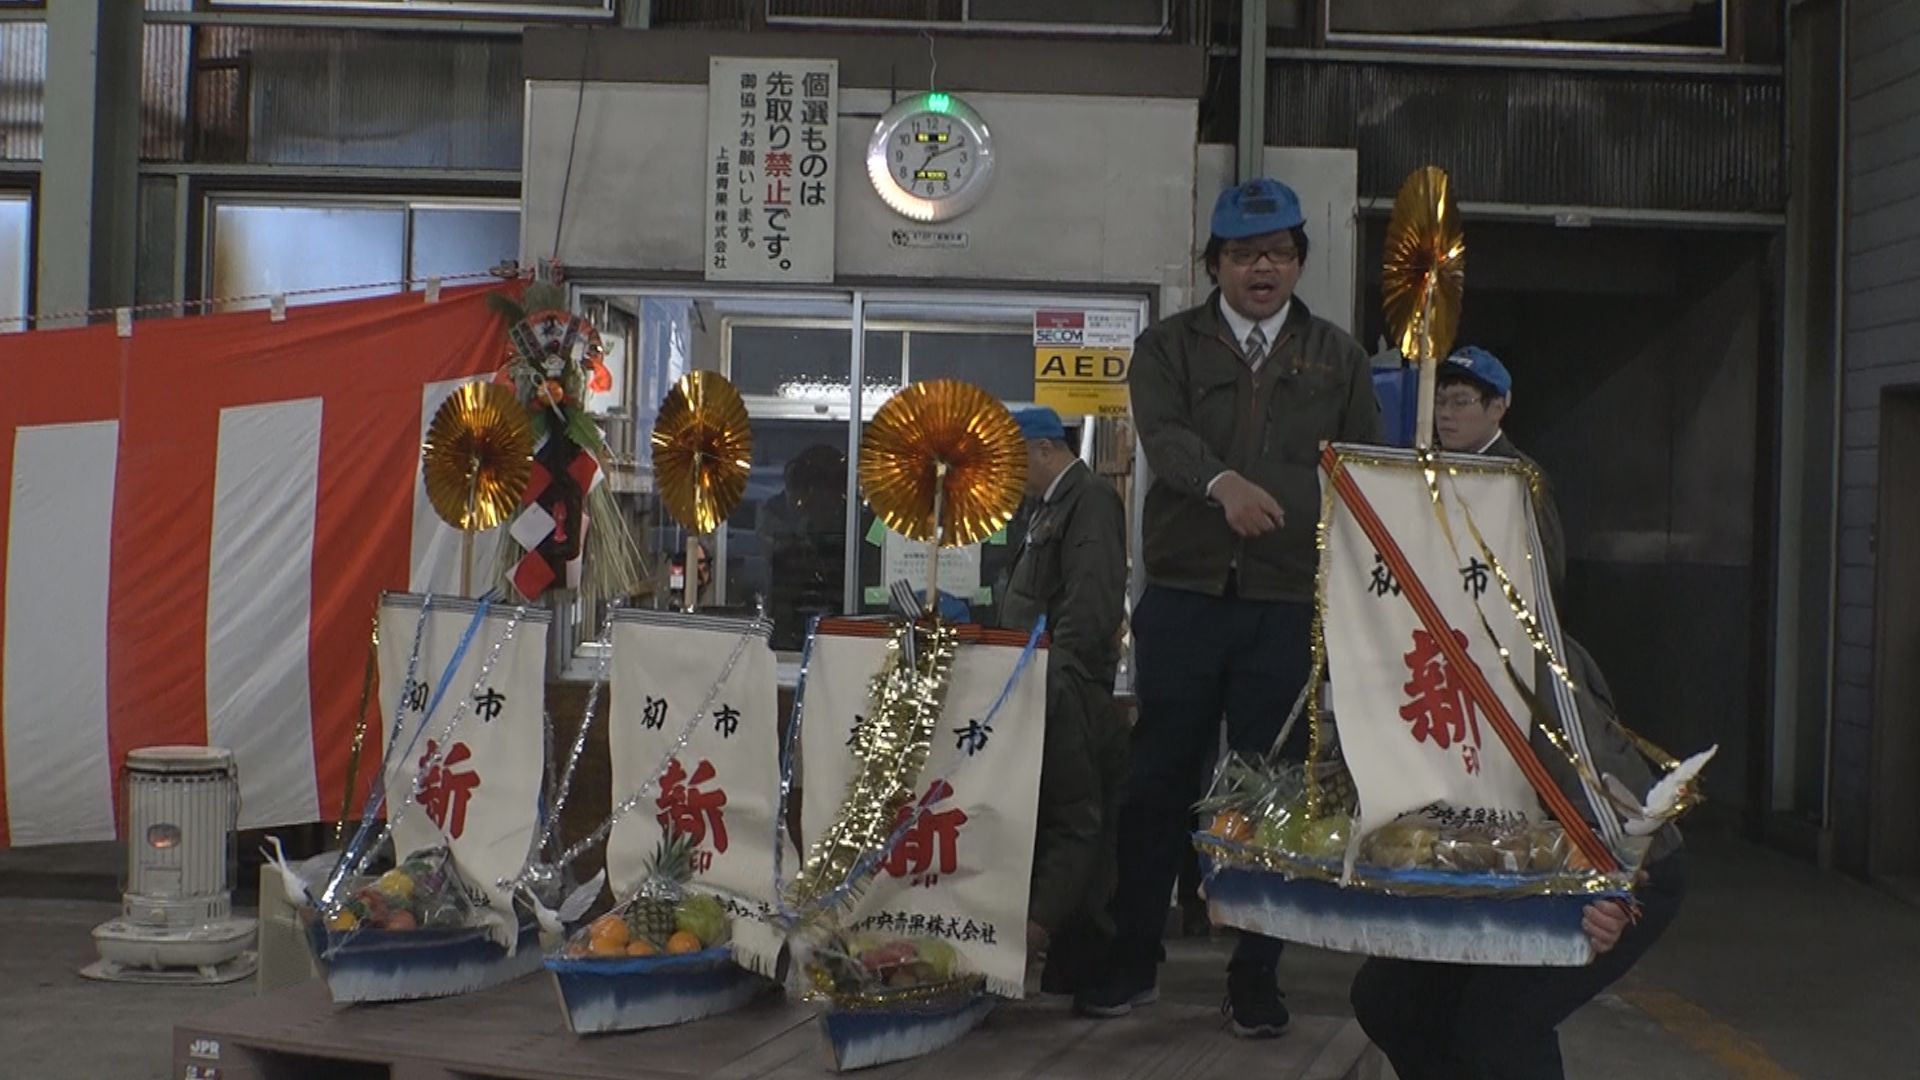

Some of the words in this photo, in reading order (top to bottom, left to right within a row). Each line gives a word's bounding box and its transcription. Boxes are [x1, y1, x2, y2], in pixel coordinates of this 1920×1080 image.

[927, 118, 939, 130] 12
[800, 71, 829, 206] 個選ものは
[901, 134, 911, 146] 10
[738, 74, 757, 249] 御協力お願いします。
[897, 150, 904, 162] 9
[961, 151, 967, 163] 3
[763, 71, 793, 270] 先取り禁止です。
[900, 166, 907, 179] 8
[955, 167, 961, 178] 4
[927, 182, 934, 194] 6
[943, 180, 950, 191] 5
[714, 146, 729, 269] 上越青果株式会社
[1036, 330, 1083, 341] SECOM
[1041, 355, 1125, 377] AED
[1459, 556, 1490, 600] 市
[1400, 628, 1482, 750] 新
[475, 687, 506, 722] 市
[641, 695, 668, 730] 初
[713, 704, 741, 739] 市
[953, 719, 993, 756] 市
[415, 738, 480, 839] 新
[656, 757, 728, 854] 新
[190, 1040, 219, 1054] JPR
